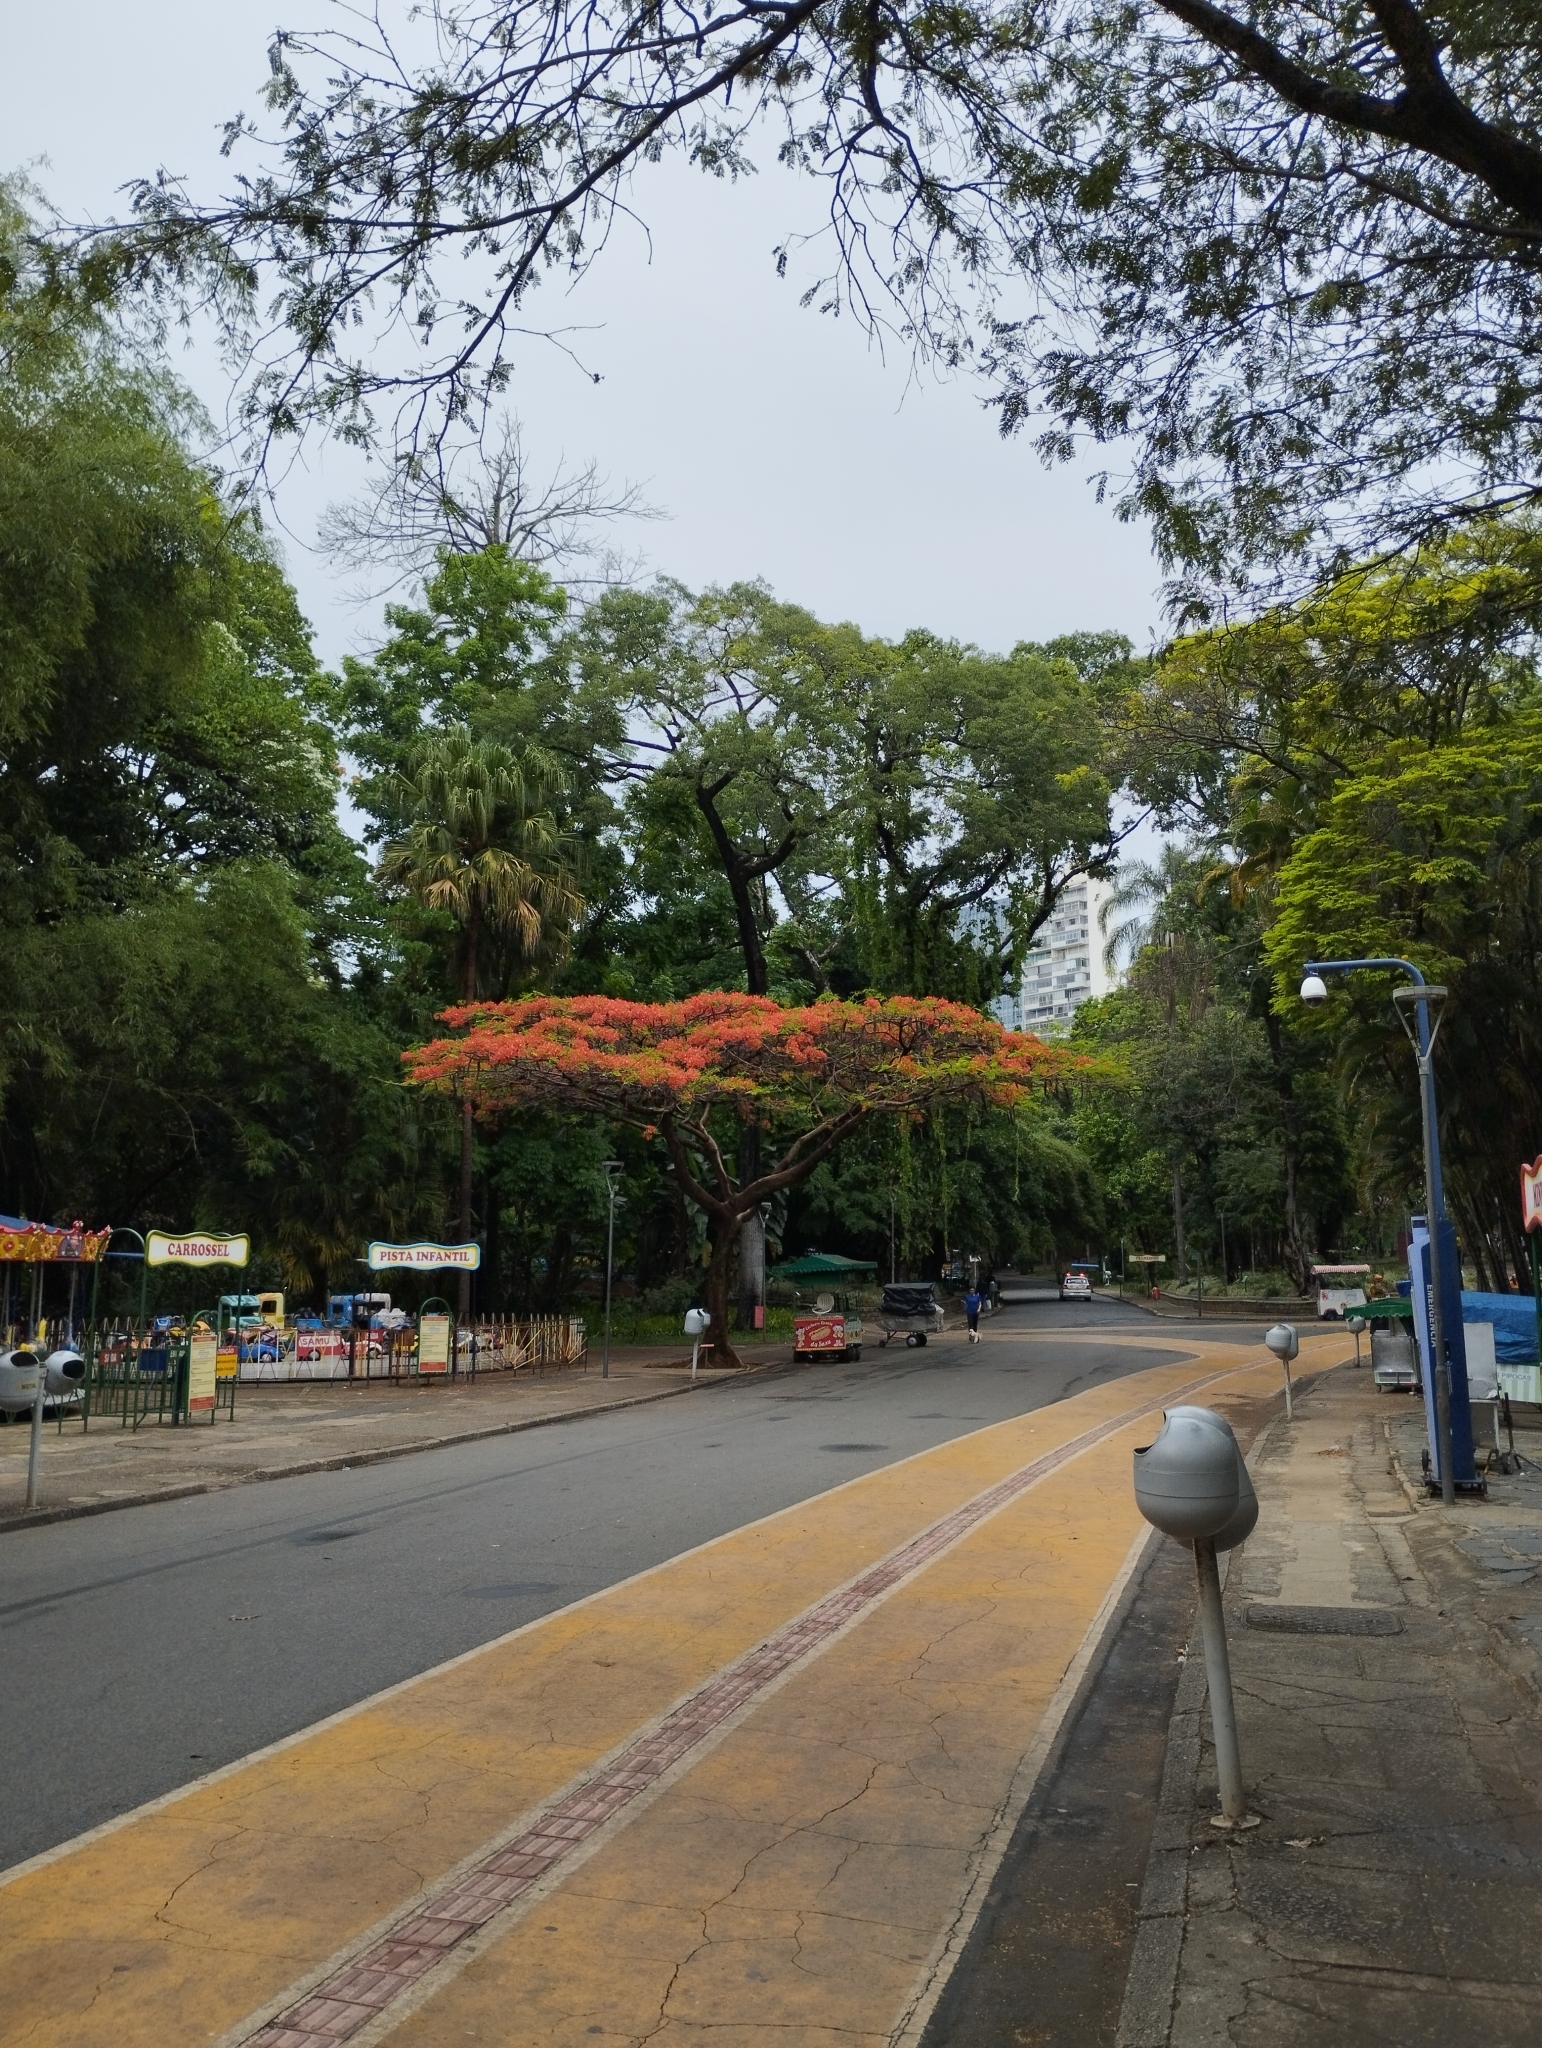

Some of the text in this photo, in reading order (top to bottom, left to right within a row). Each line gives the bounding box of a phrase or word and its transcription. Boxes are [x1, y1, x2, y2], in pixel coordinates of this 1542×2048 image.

[167, 1242, 230, 1257] CARROSSEL
[380, 1251, 470, 1262] PISTA INFANTIL
[1501, 1372, 1532, 1382] PIPOCAS
